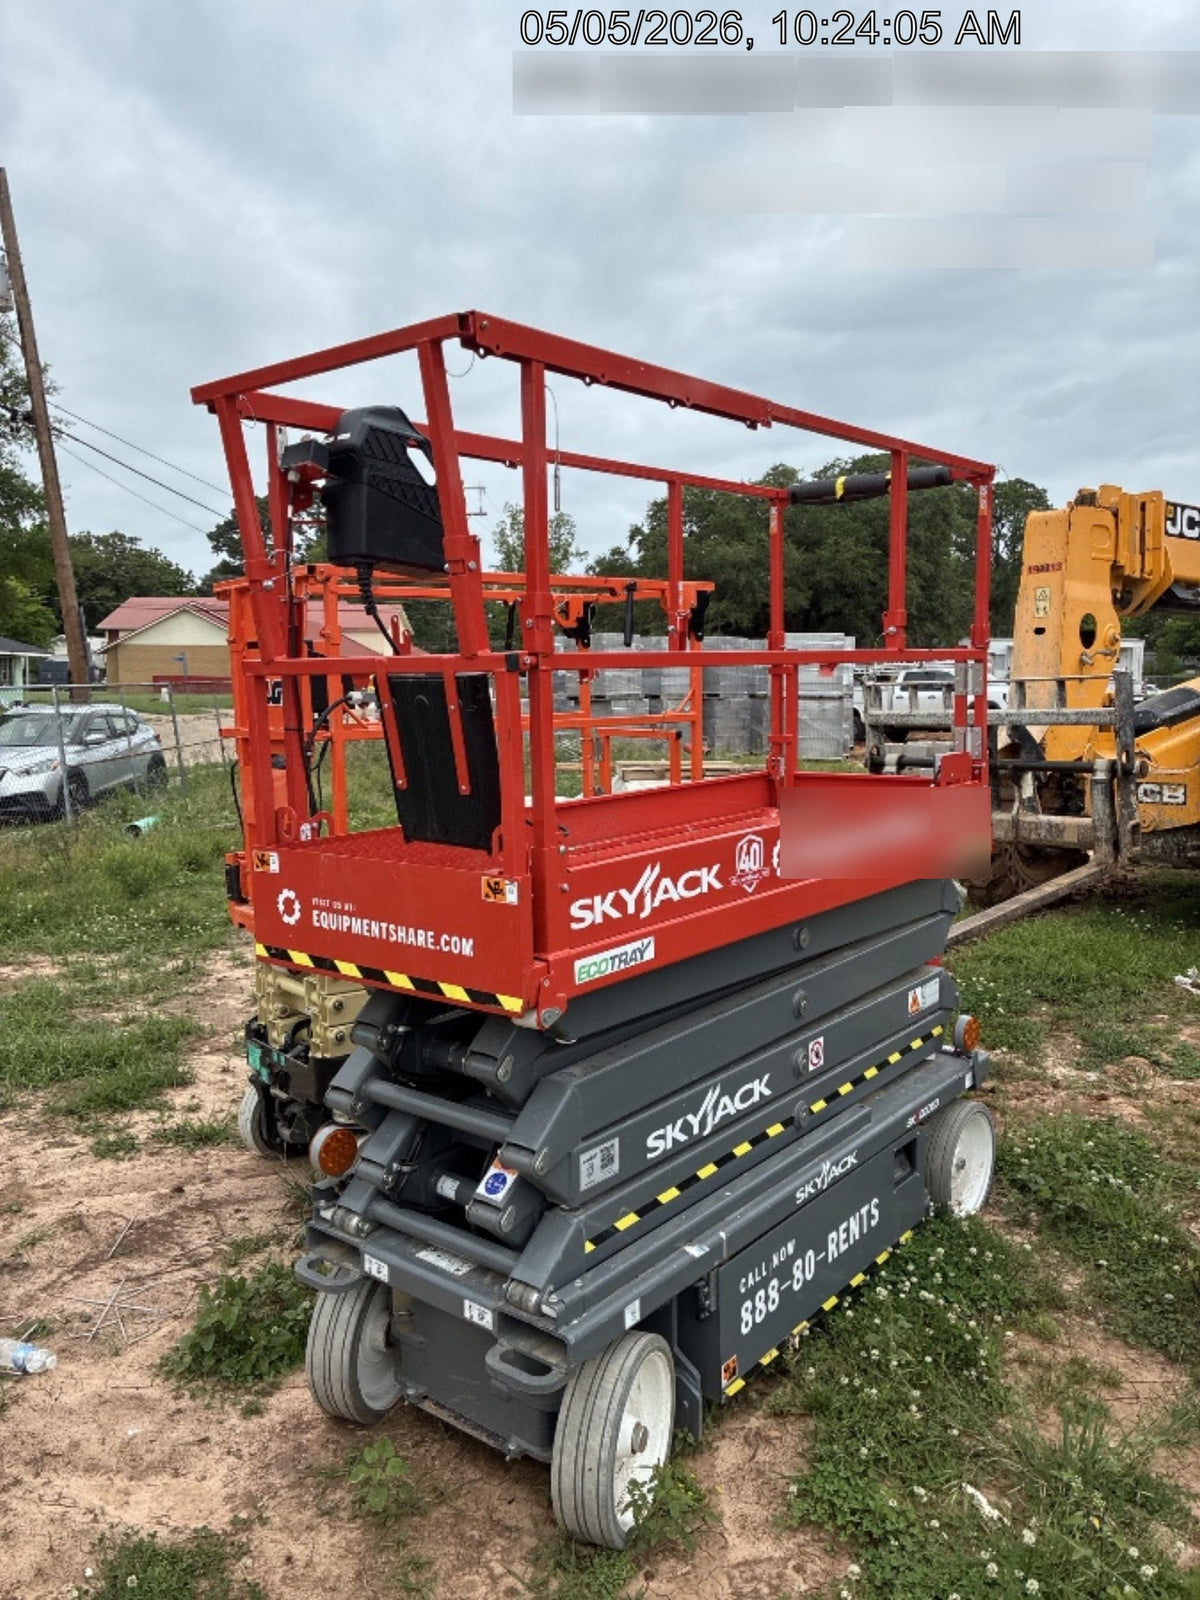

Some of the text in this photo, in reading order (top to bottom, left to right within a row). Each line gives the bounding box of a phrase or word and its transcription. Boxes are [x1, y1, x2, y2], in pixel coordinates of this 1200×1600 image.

[1166, 506, 1200, 538] JC
[1137, 783, 1186, 804] CB
[569, 861, 724, 930] SKYJACK
[312, 909, 475, 957] EQUIPMENTSHARE.COM
[577, 939, 652, 982] ECOTRAY
[646, 1073, 772, 1159] SKYJACK
[795, 1150, 859, 1205] SKYJACK
[739, 1238, 796, 1294] CALL NOW
[740, 1197, 880, 1336] 888-80-RENTS
